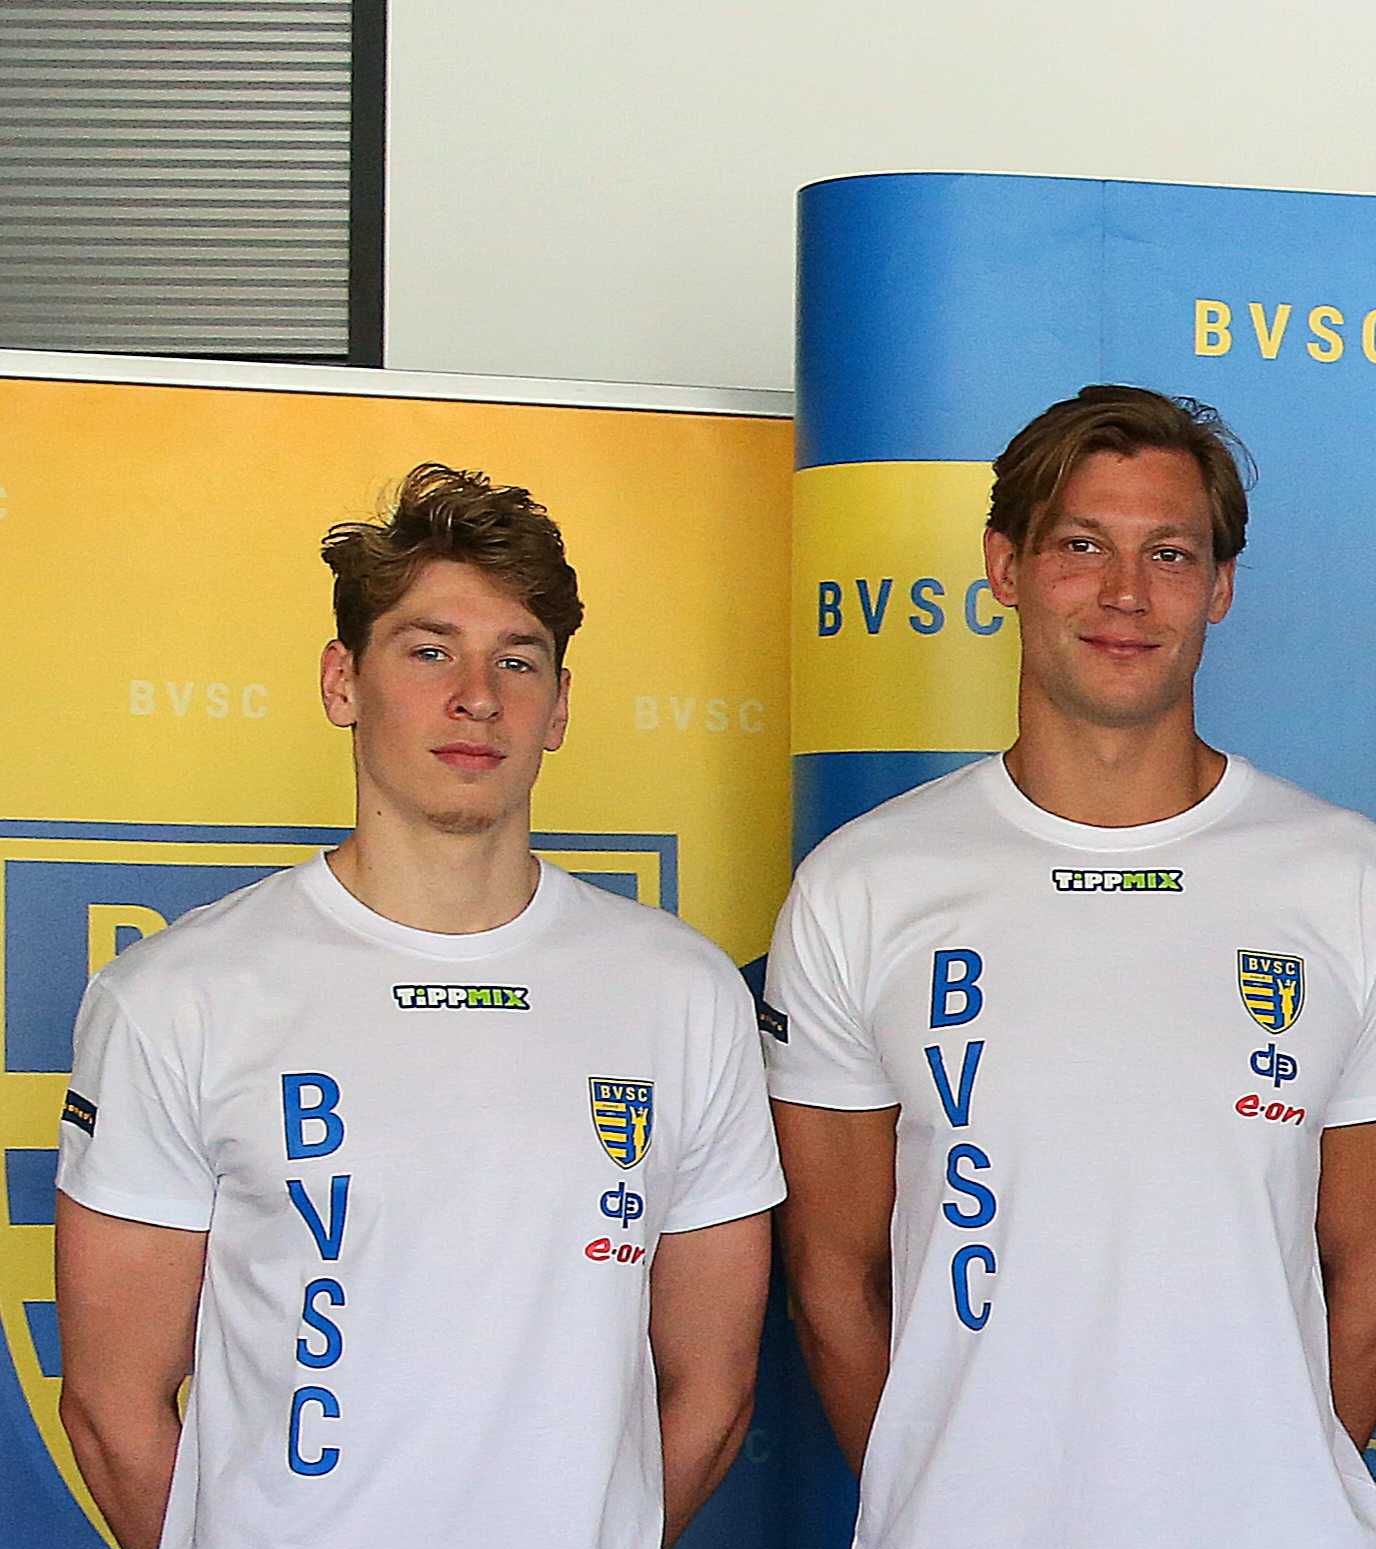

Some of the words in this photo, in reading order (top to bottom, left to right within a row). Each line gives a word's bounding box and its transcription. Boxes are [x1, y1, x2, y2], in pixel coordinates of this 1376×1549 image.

[817, 577, 1004, 637] BVSC
[129, 680, 268, 719] BVSC
[634, 697, 766, 734] BVSC
[1248, 955, 1297, 976] BVSC
[600, 1085, 648, 1102] BVSC
[922, 948, 999, 1333] BVSC
[281, 1071, 352, 1478] BVSC
